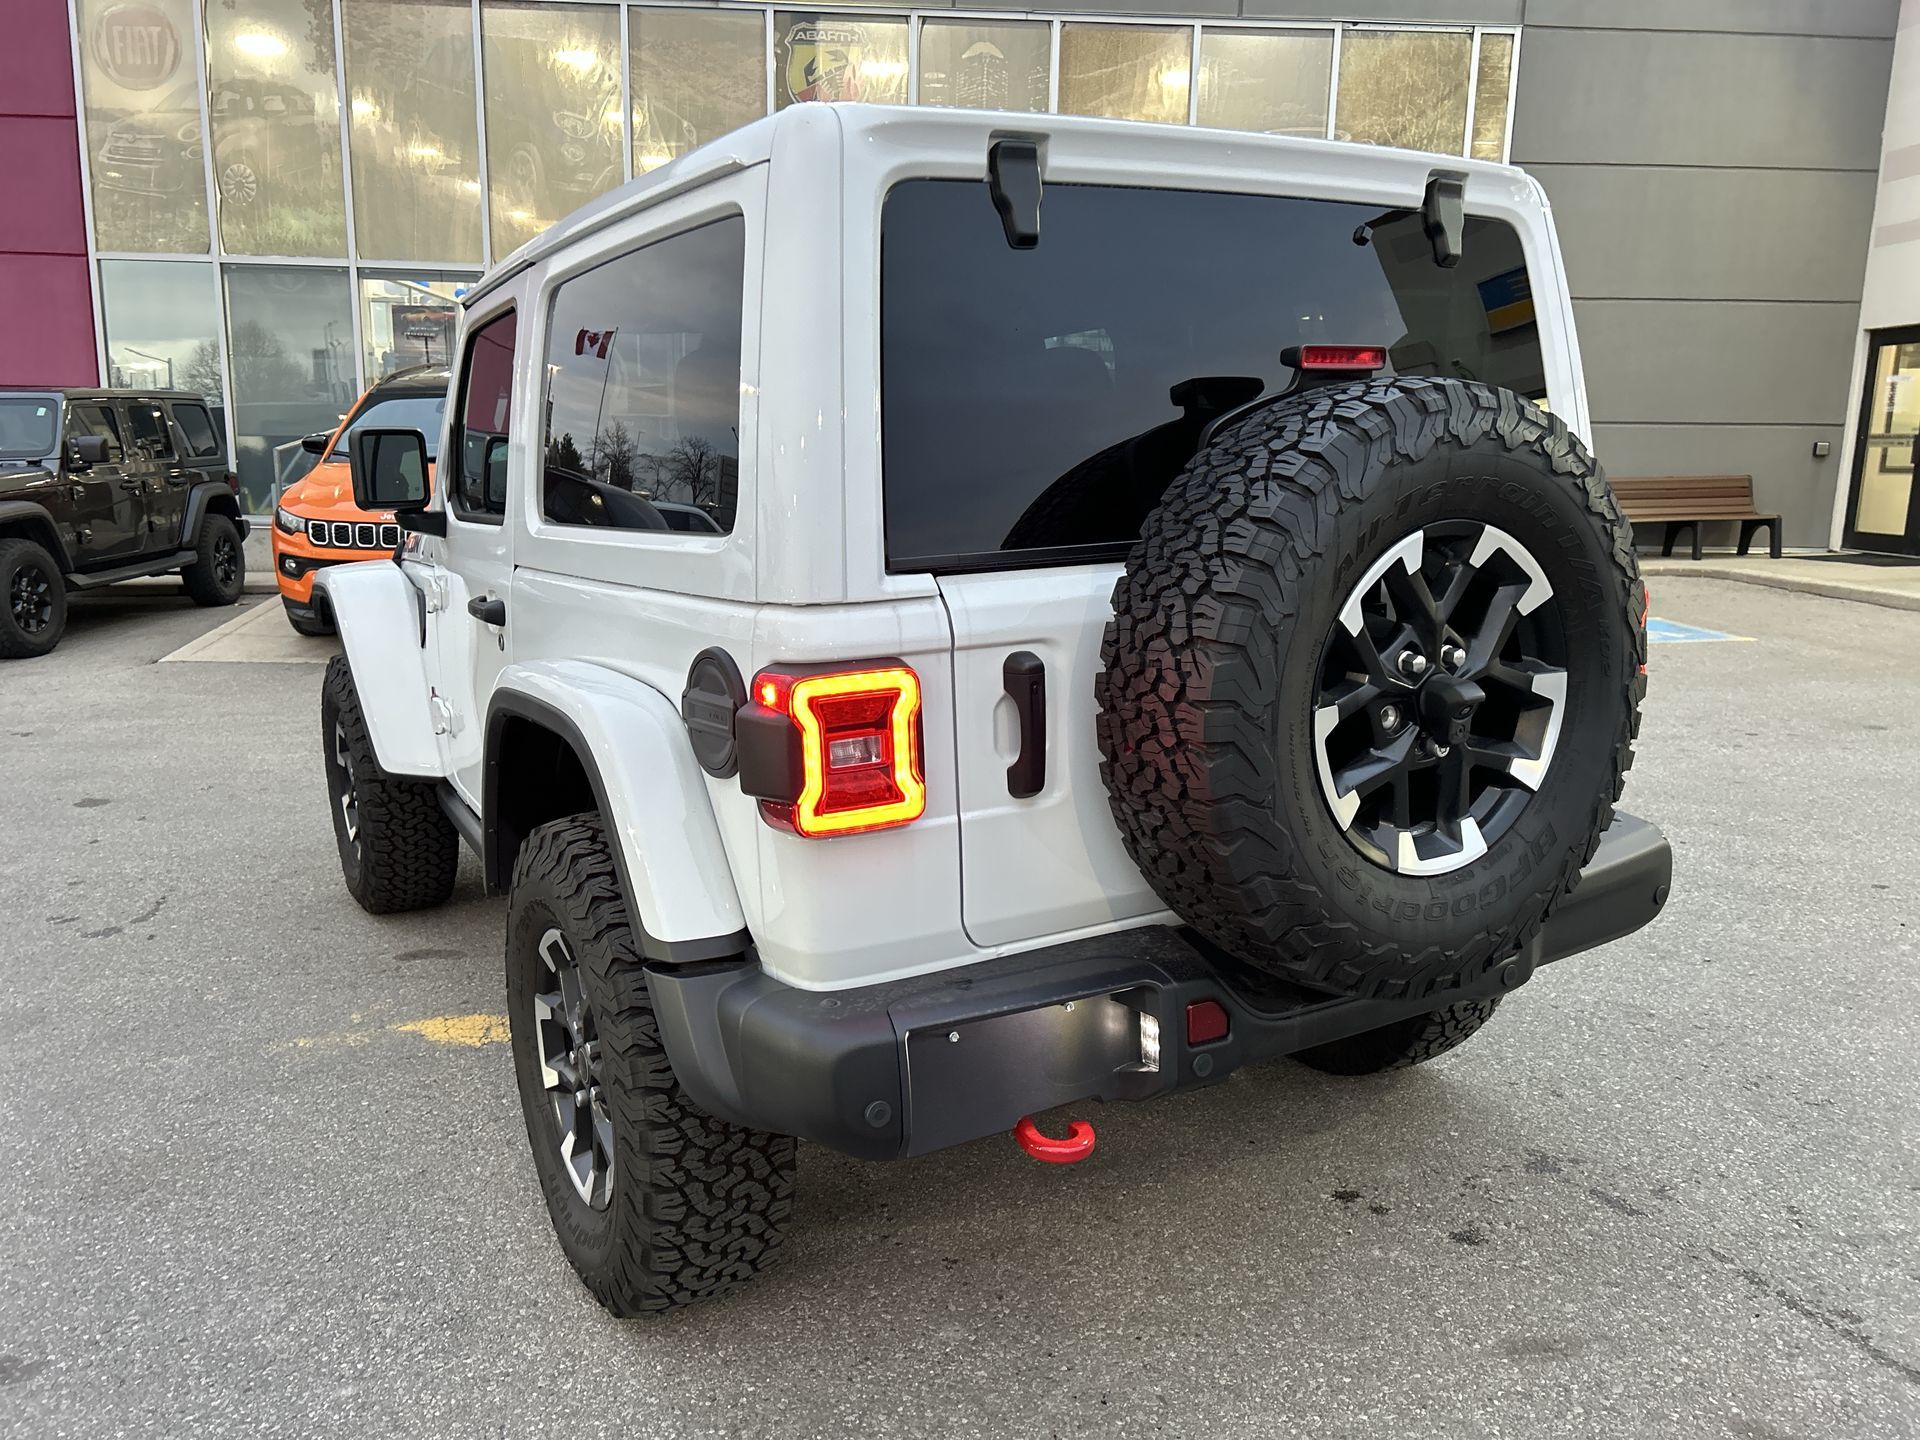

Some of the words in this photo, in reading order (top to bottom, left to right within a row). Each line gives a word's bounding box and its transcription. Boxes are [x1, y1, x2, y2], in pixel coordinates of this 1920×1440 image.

[112, 25, 162, 65] FIAT
[794, 30, 860, 42] ABARTH
[1317, 822, 1558, 922] BFGoodrich
